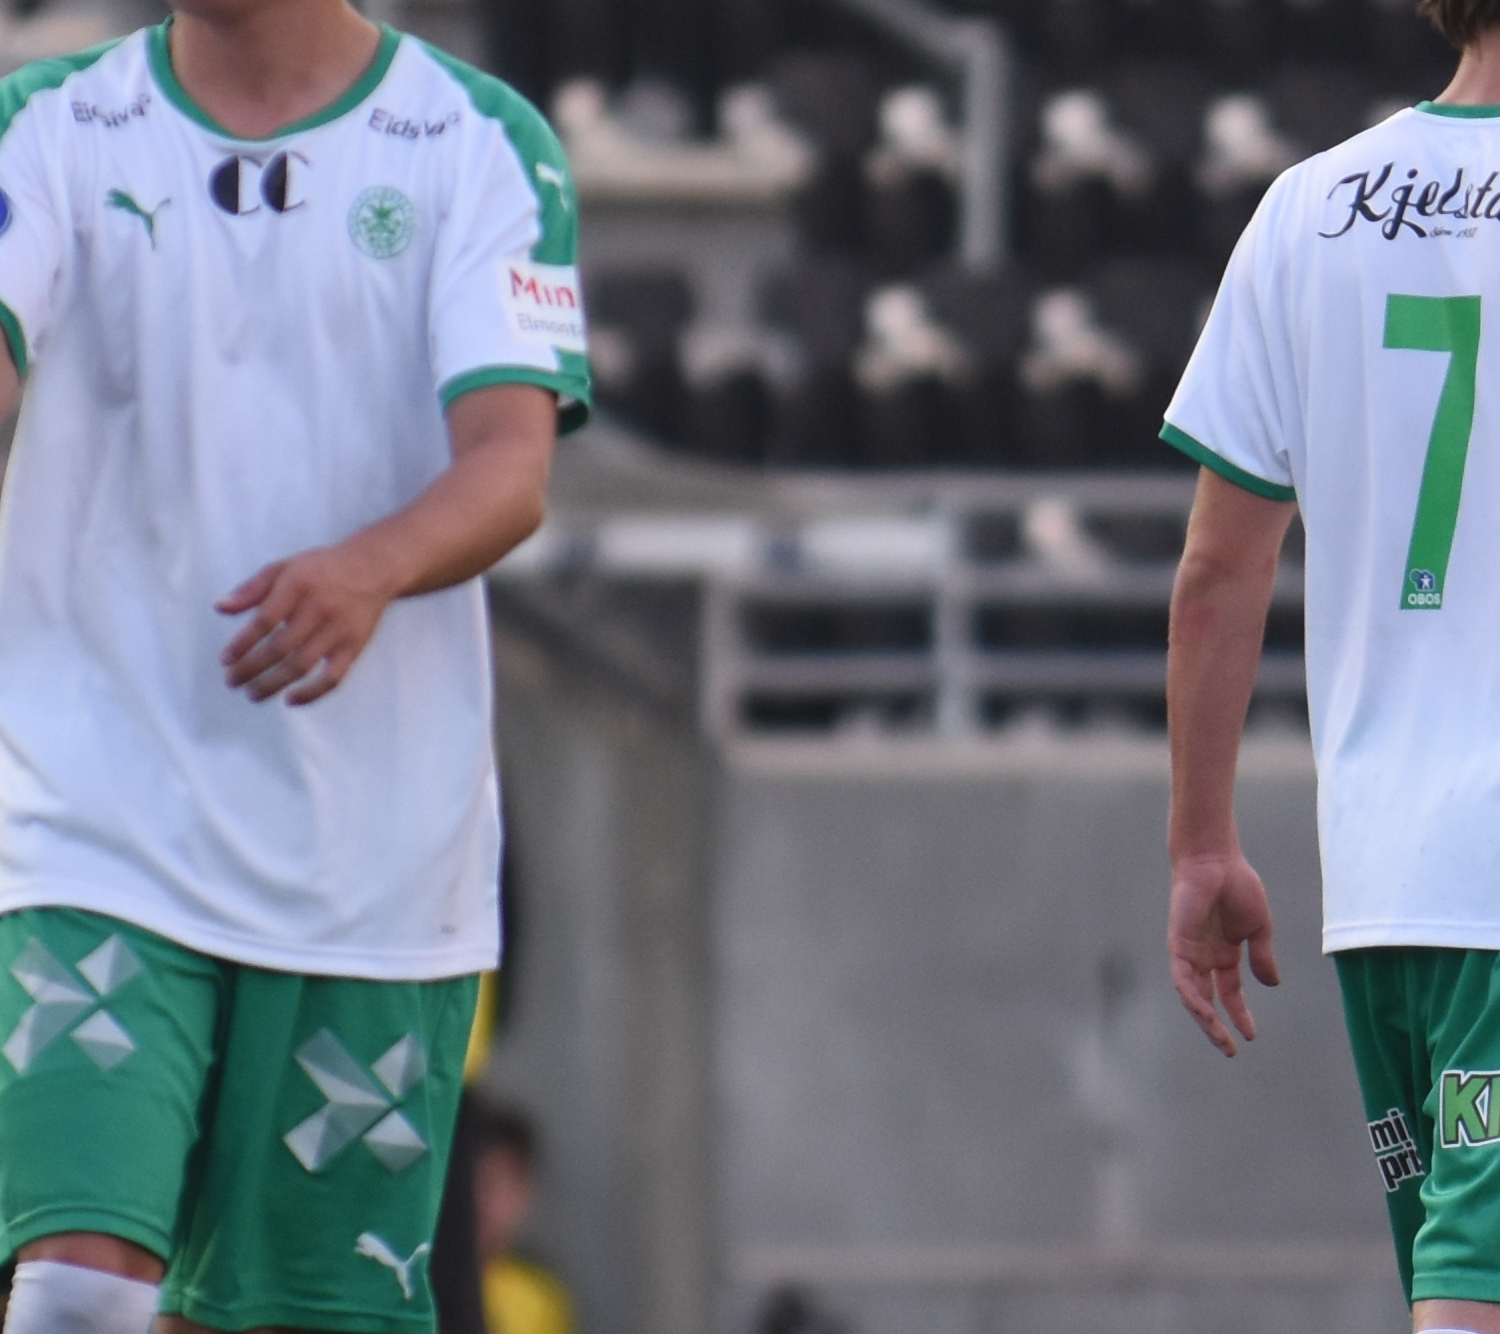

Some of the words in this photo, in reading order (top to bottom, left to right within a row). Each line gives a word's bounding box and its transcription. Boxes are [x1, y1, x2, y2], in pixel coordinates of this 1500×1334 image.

[508, 267, 576, 308] Min
[1382, 293, 1482, 609] 7
[1407, 593, 1441, 605] OBOS
[1368, 1108, 1409, 1151] mi
[1378, 1140, 1423, 1191] pri
